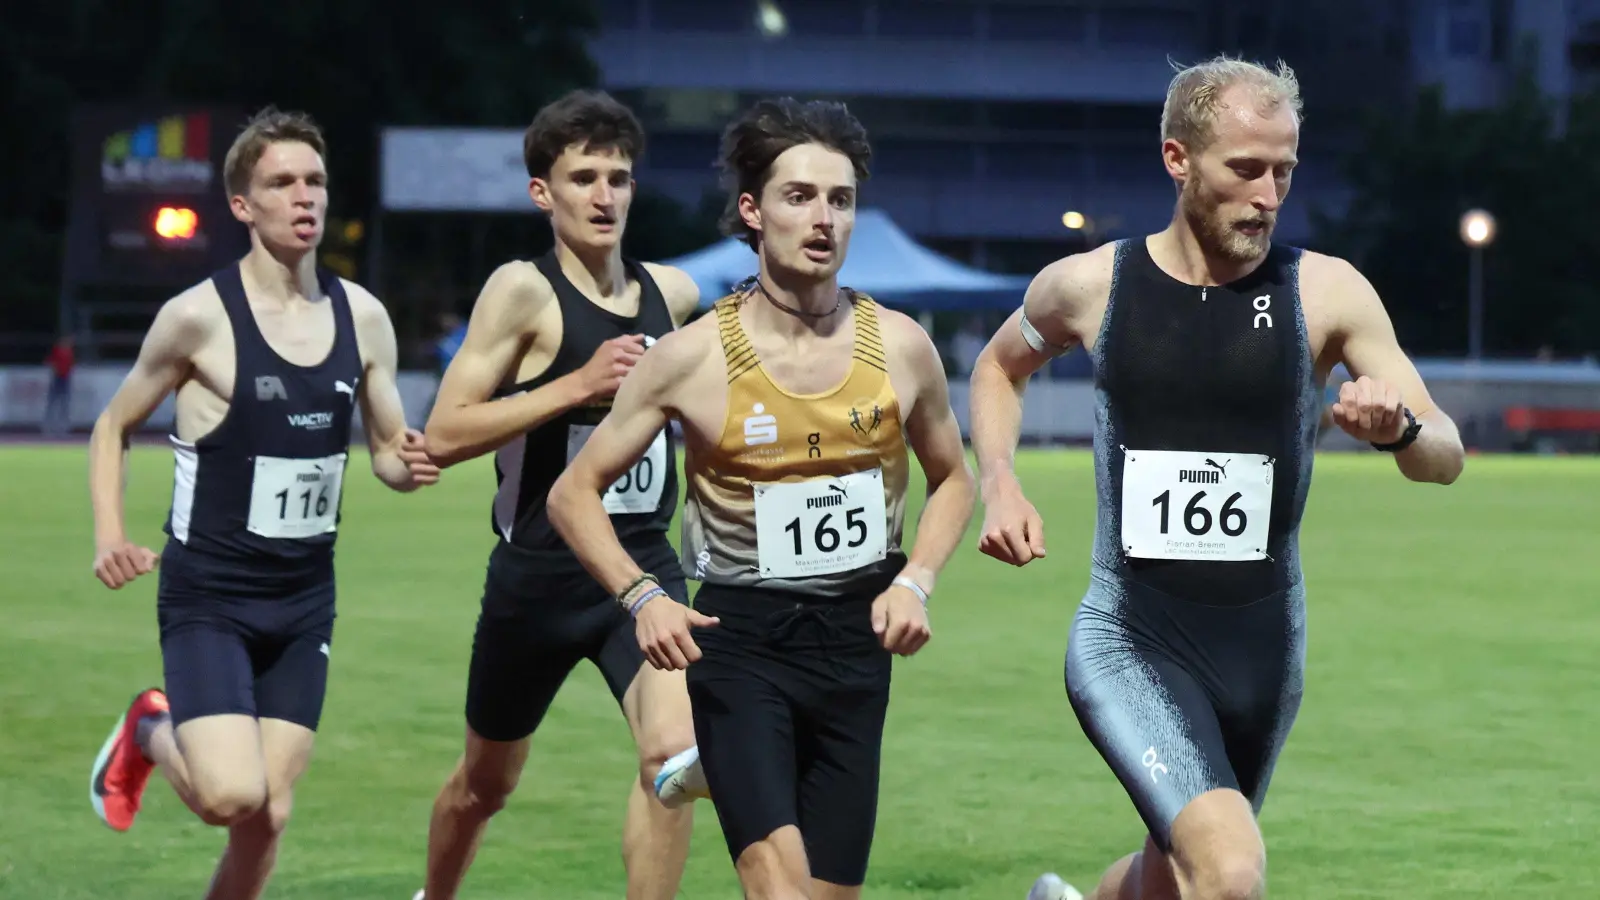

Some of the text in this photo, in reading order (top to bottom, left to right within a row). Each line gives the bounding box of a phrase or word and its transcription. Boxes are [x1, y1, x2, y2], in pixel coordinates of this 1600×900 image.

[287, 412, 334, 427] VIACTIV
[606, 456, 653, 494] 50
[1179, 469, 1219, 484] PUMA
[275, 486, 329, 519] 116
[806, 494, 842, 510] PUMA
[1152, 489, 1248, 537] 166
[785, 507, 868, 556] 165
